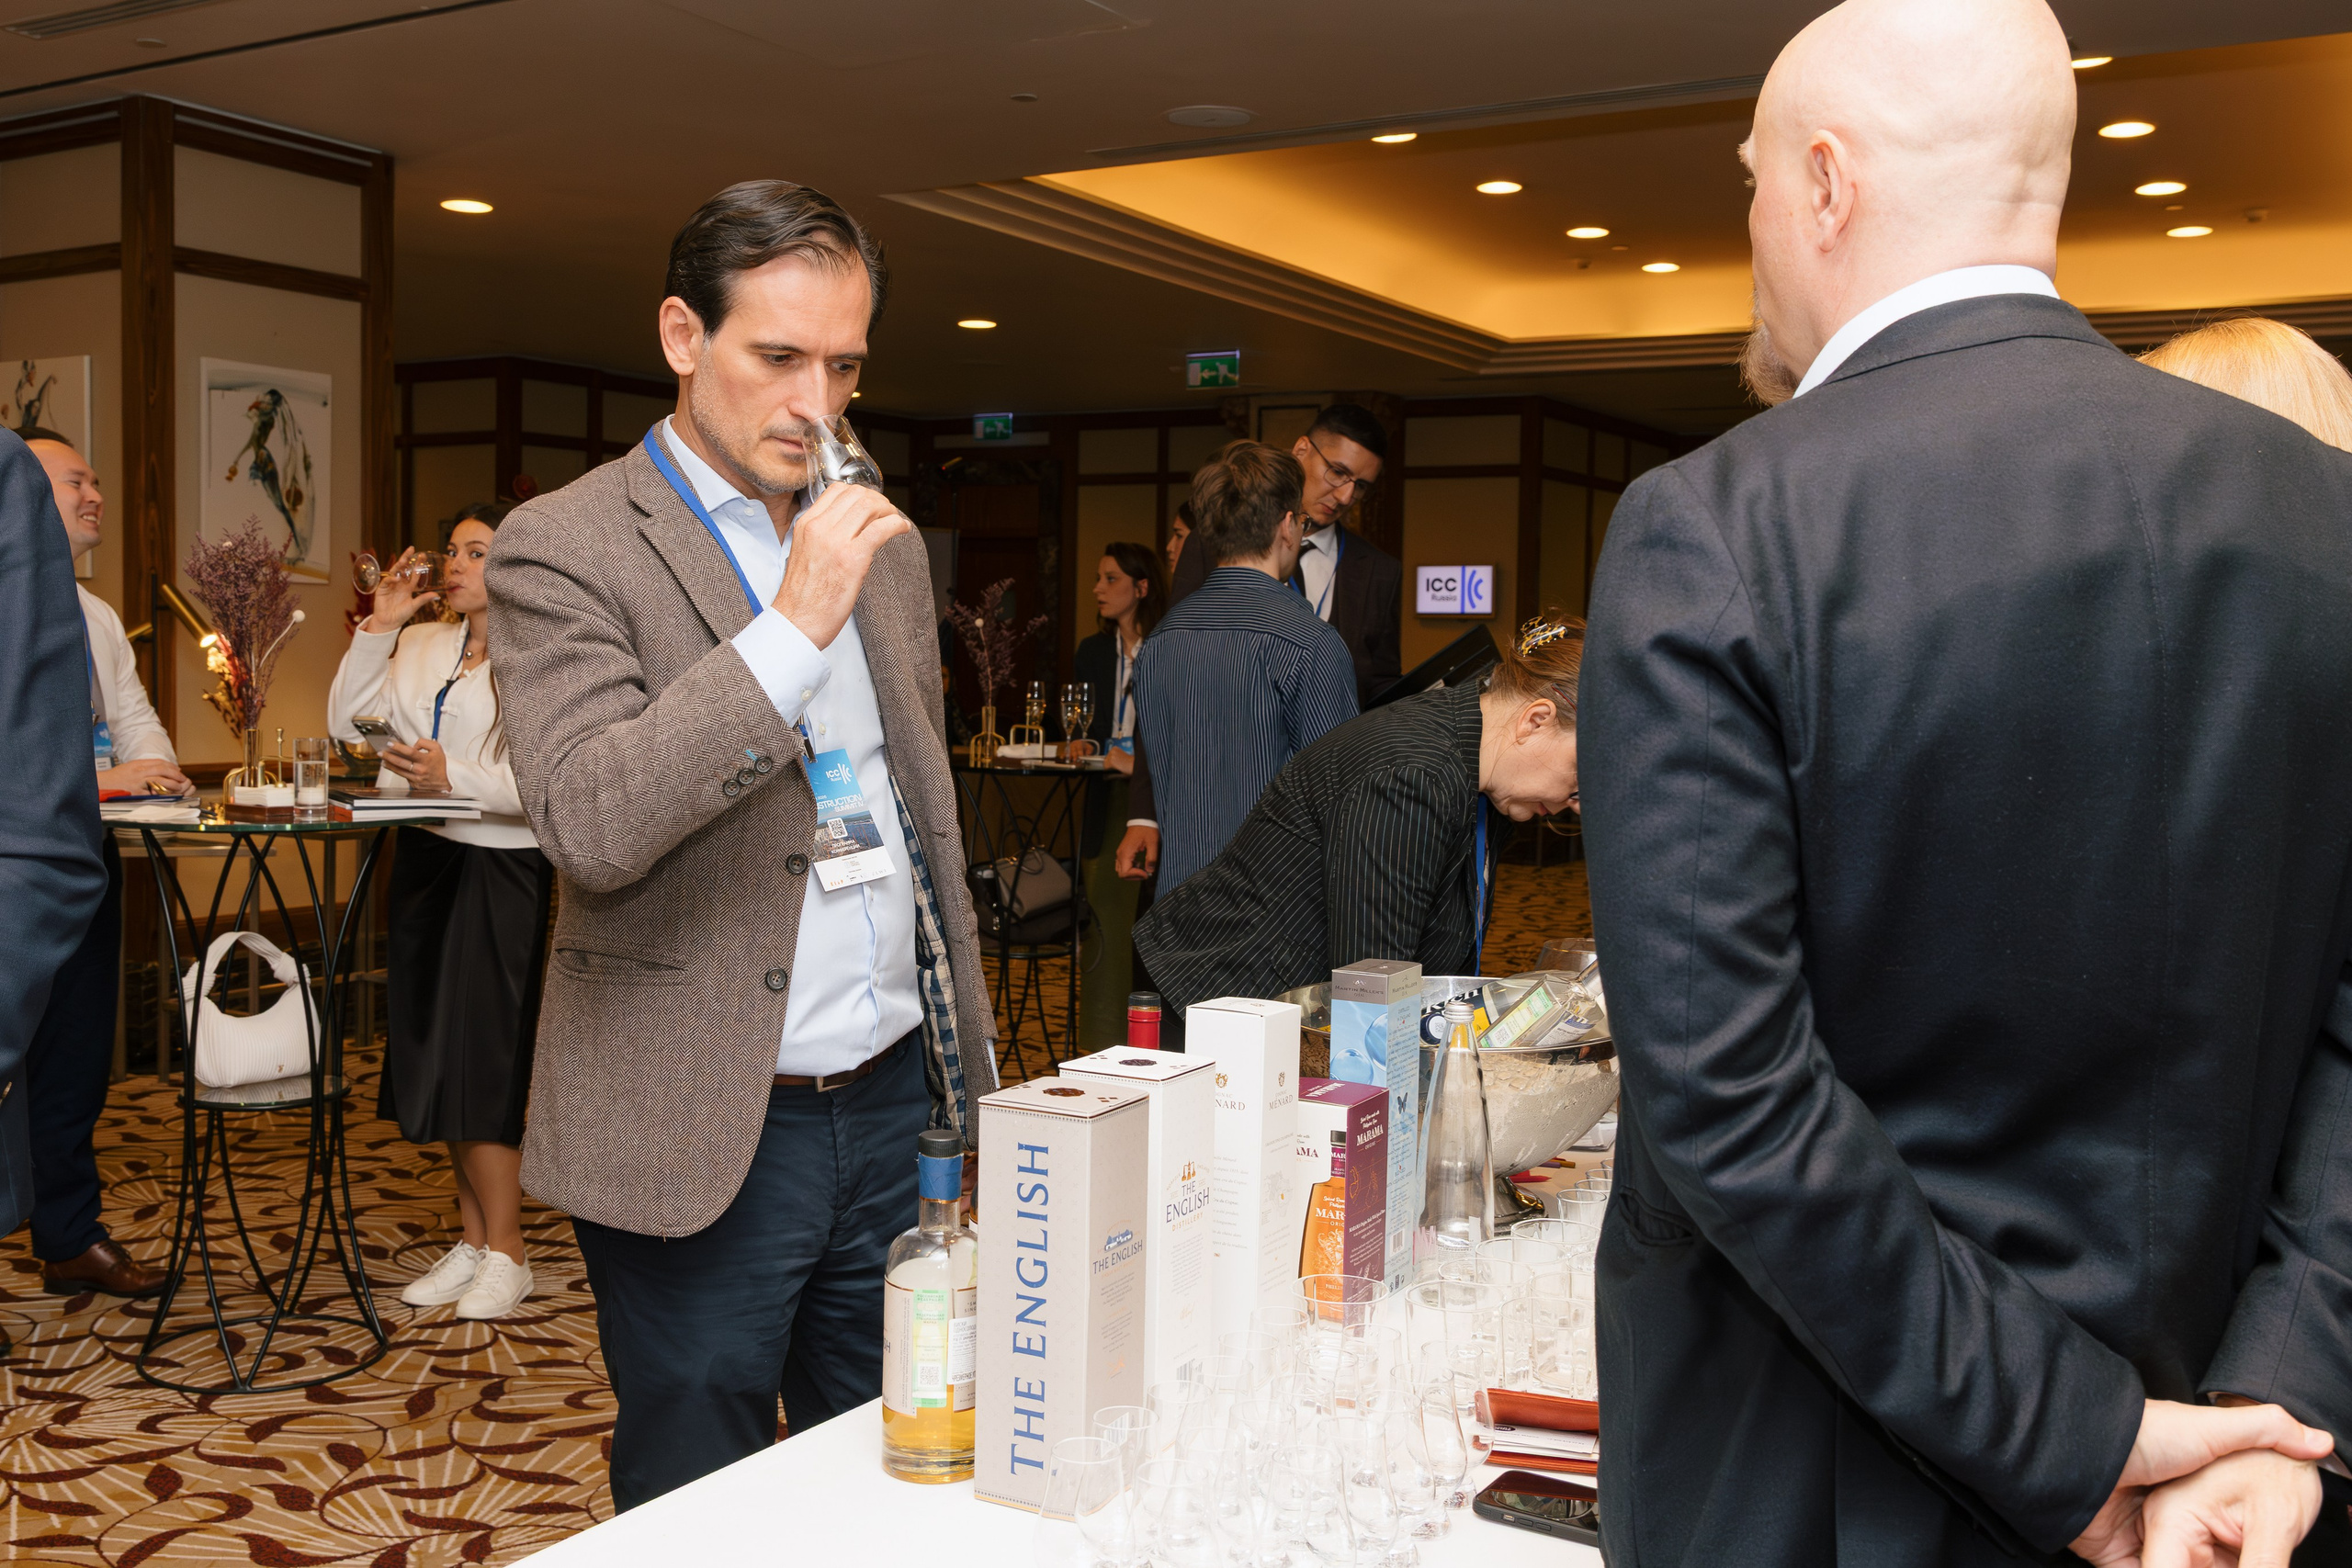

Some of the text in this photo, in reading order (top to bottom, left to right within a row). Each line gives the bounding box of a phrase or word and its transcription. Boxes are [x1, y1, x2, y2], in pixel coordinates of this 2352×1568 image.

[1426, 578, 1457, 592] ICC
[1431, 593, 1457, 602] Russia
[826, 770, 841, 778] ICC
[817, 794, 863, 809] STRUCTION
[1215, 1099, 1246, 1111] NARD
[1269, 1094, 1294, 1111] MÉNARD
[1356, 1124, 1384, 1146] MARAMA
[1296, 1146, 1318, 1157] AMA
[1182, 1180, 1195, 1196] THE
[1166, 1187, 1209, 1223] ENGLISH
[1172, 1212, 1203, 1231] DISTILLERY
[1316, 1207, 1345, 1221] MAR
[1093, 1239, 1143, 1274] THE ENGLISH
[1011, 1142, 1049, 1475] THE ENGLISH
